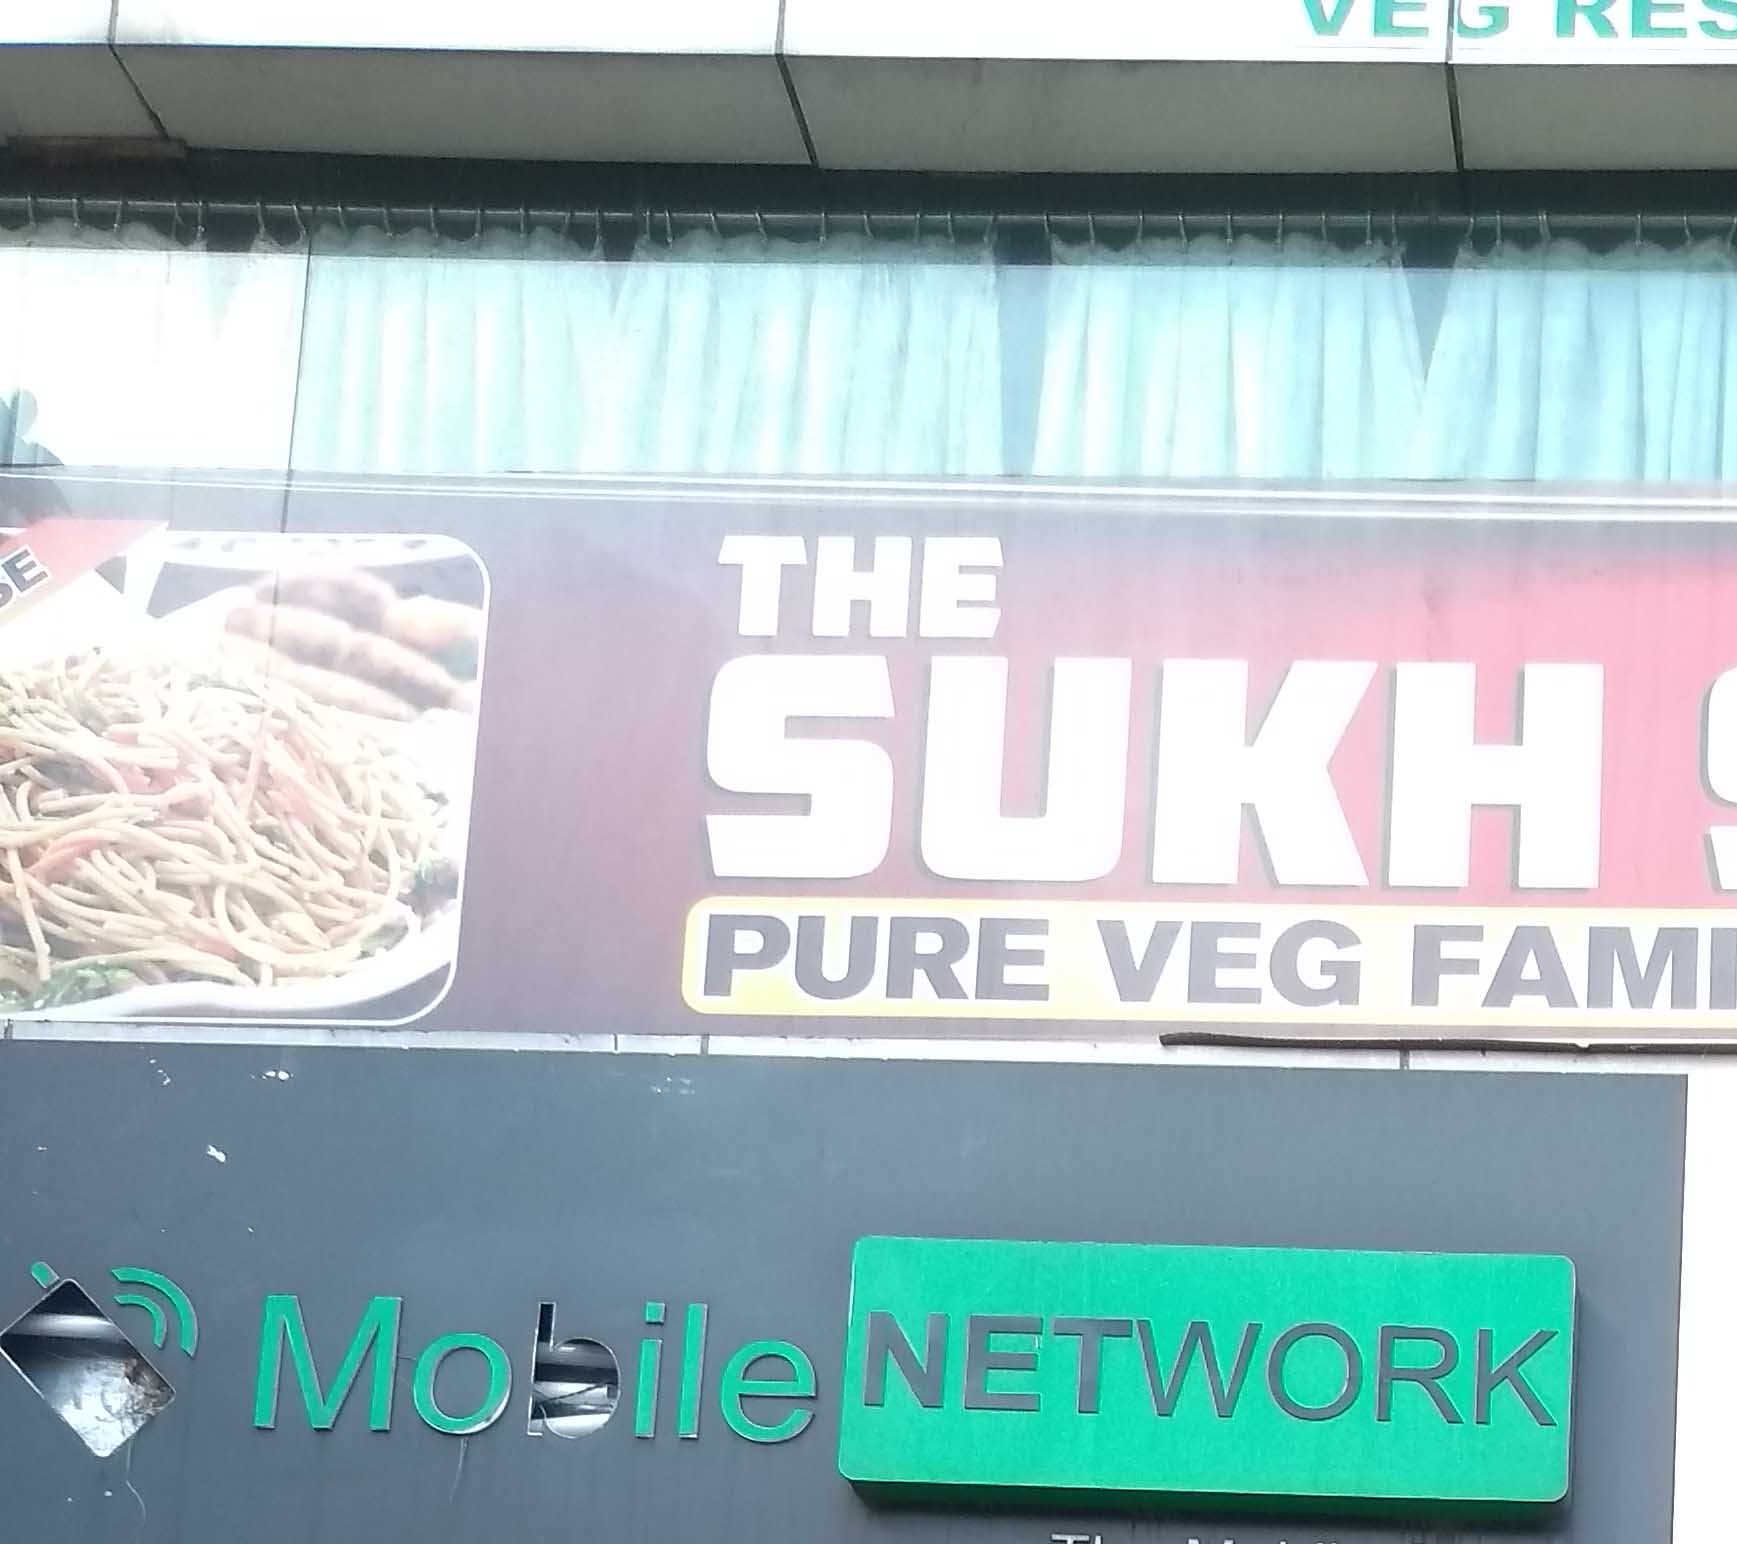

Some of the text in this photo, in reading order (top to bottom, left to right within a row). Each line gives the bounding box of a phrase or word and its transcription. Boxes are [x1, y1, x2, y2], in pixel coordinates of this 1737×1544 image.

[1306, 0, 1503, 40] VEG
[717, 535, 1004, 638] THE
[704, 654, 1606, 894] SUKH
[702, 914, 1051, 1001] PURE
[1104, 918, 1369, 1010] VEG
[252, 1293, 1560, 1446] Mobile NETWORK
